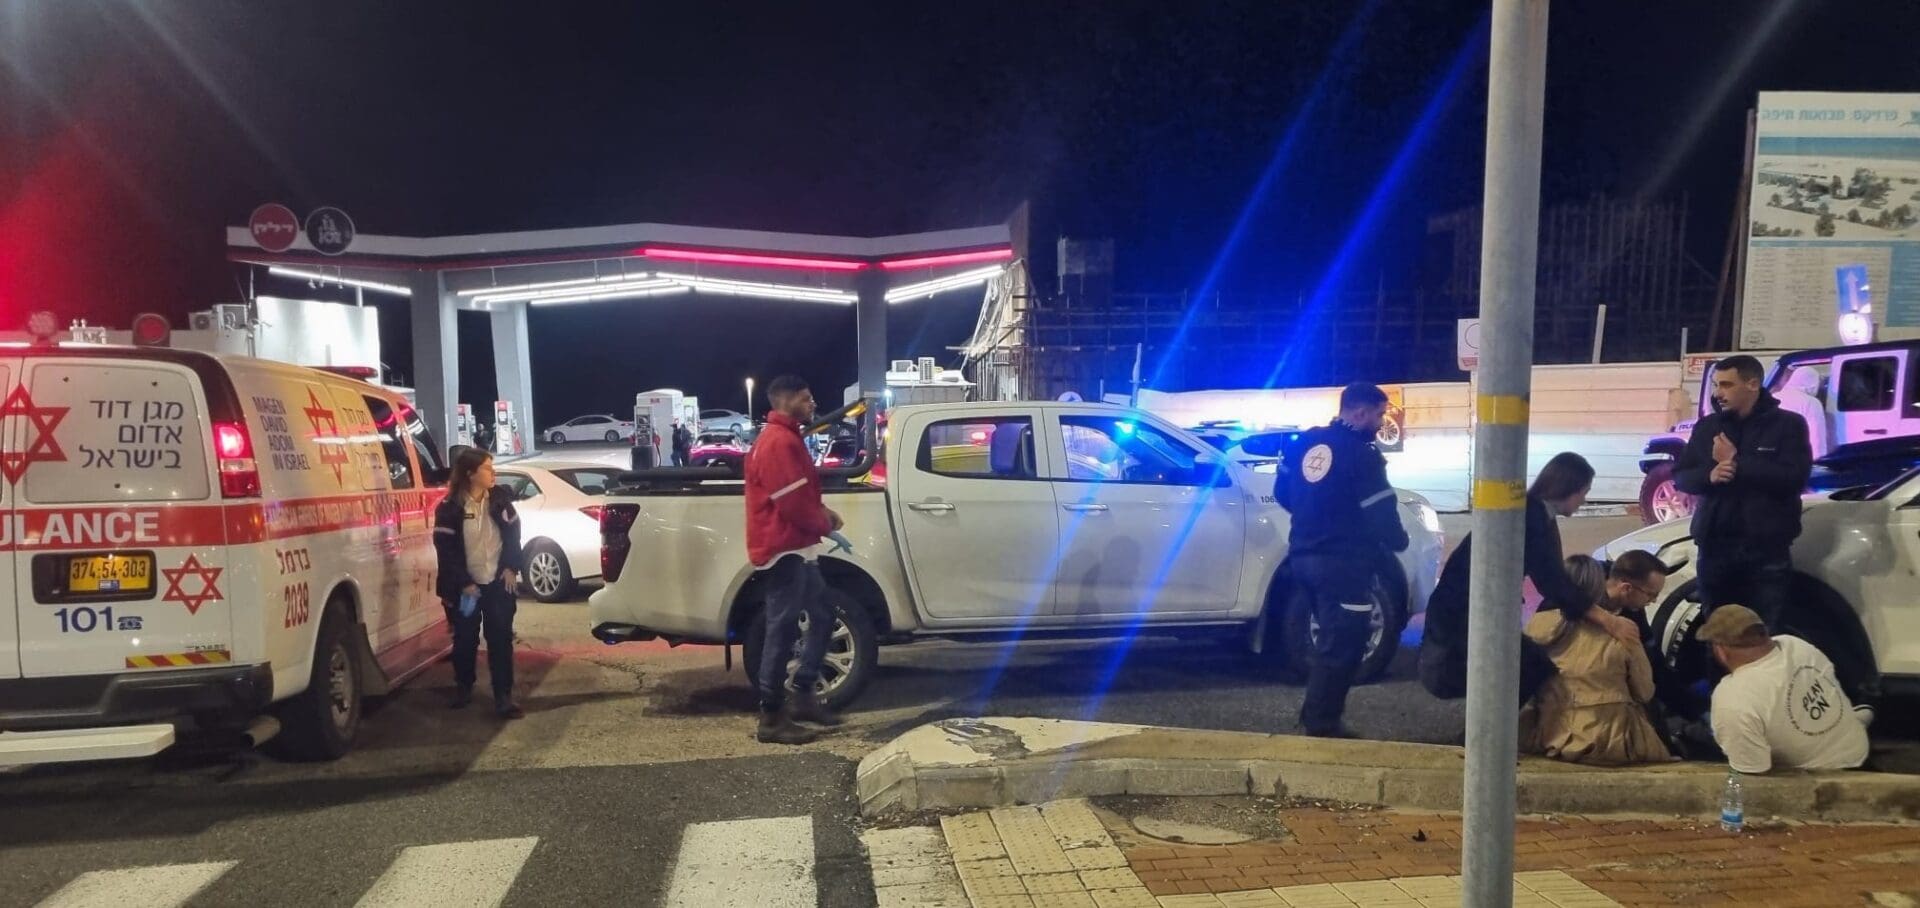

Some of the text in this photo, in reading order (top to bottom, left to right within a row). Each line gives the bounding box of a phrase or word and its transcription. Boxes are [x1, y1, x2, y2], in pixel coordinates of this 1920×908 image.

[90, 400, 184, 423] מגן דוד
[252, 396, 286, 415] MAGEN
[118, 425, 182, 444] אדום
[260, 415, 288, 433] DAVID
[267, 434, 296, 452] ADOM
[79, 445, 182, 468] בישראל
[272, 453, 311, 470] IN ISRAEL
[284, 581, 309, 629] 2039
[54, 606, 113, 632] 101
[1802, 679, 1824, 712] PLAY
[1810, 695, 1830, 720] ON
